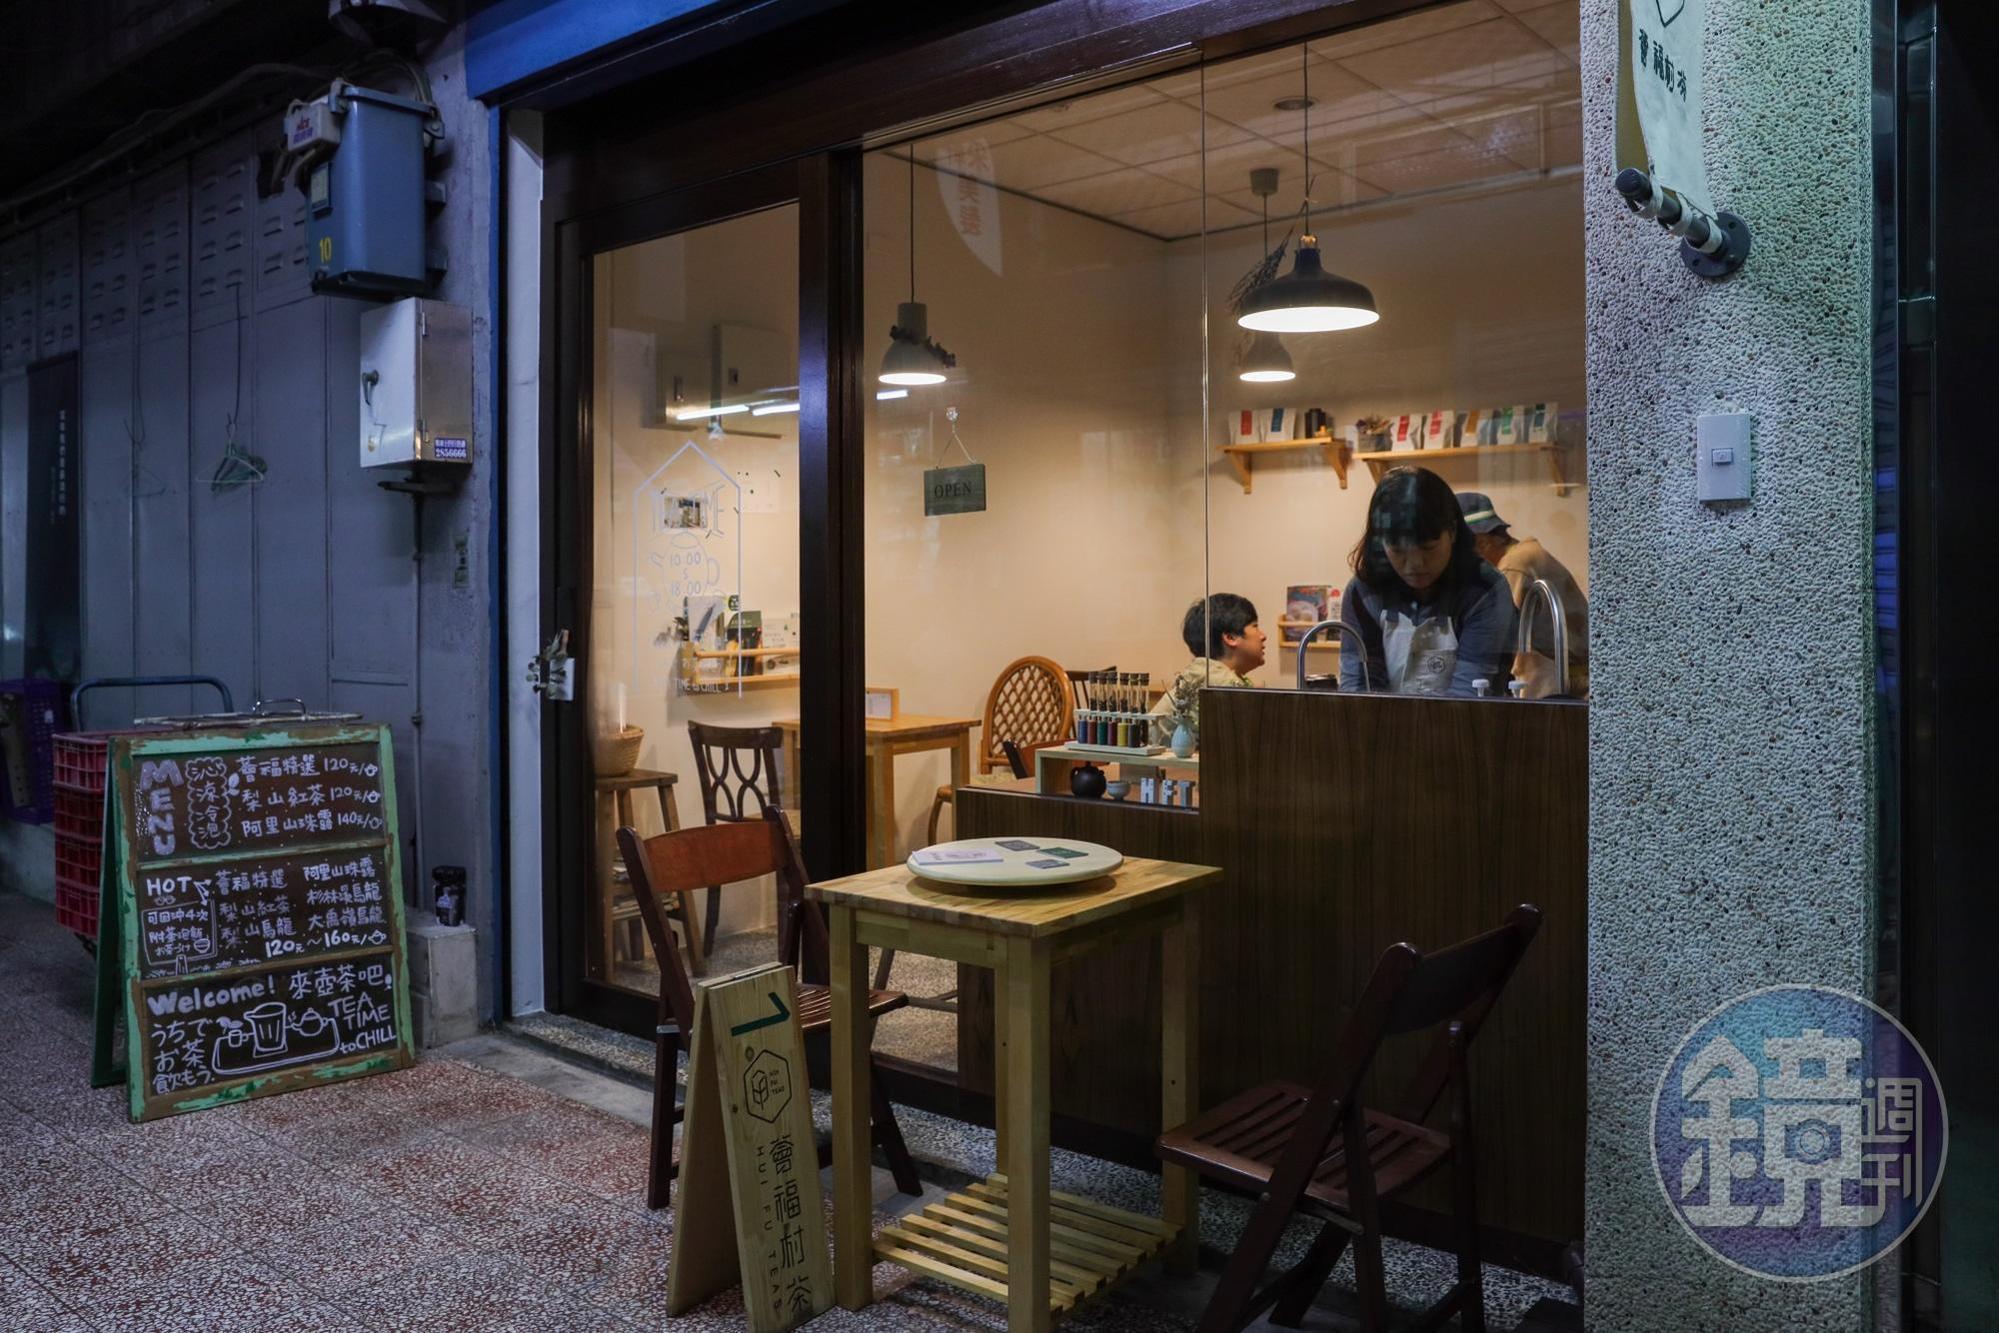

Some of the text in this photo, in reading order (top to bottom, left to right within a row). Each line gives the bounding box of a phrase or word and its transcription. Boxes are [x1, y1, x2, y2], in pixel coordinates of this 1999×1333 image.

[319, 236, 332, 263] 10
[933, 481, 973, 499] OPEN
[139, 759, 184, 856] MENU
[241, 784, 327, 812] 梨山紅茶
[146, 875, 194, 897] HOT
[327, 991, 375, 1017] TEA
[343, 1004, 391, 1030] TIME
[151, 1017, 213, 1047] うちで
[153, 1039, 206, 1073] お茶
[769, 1134, 813, 1313] 薈福村茶
